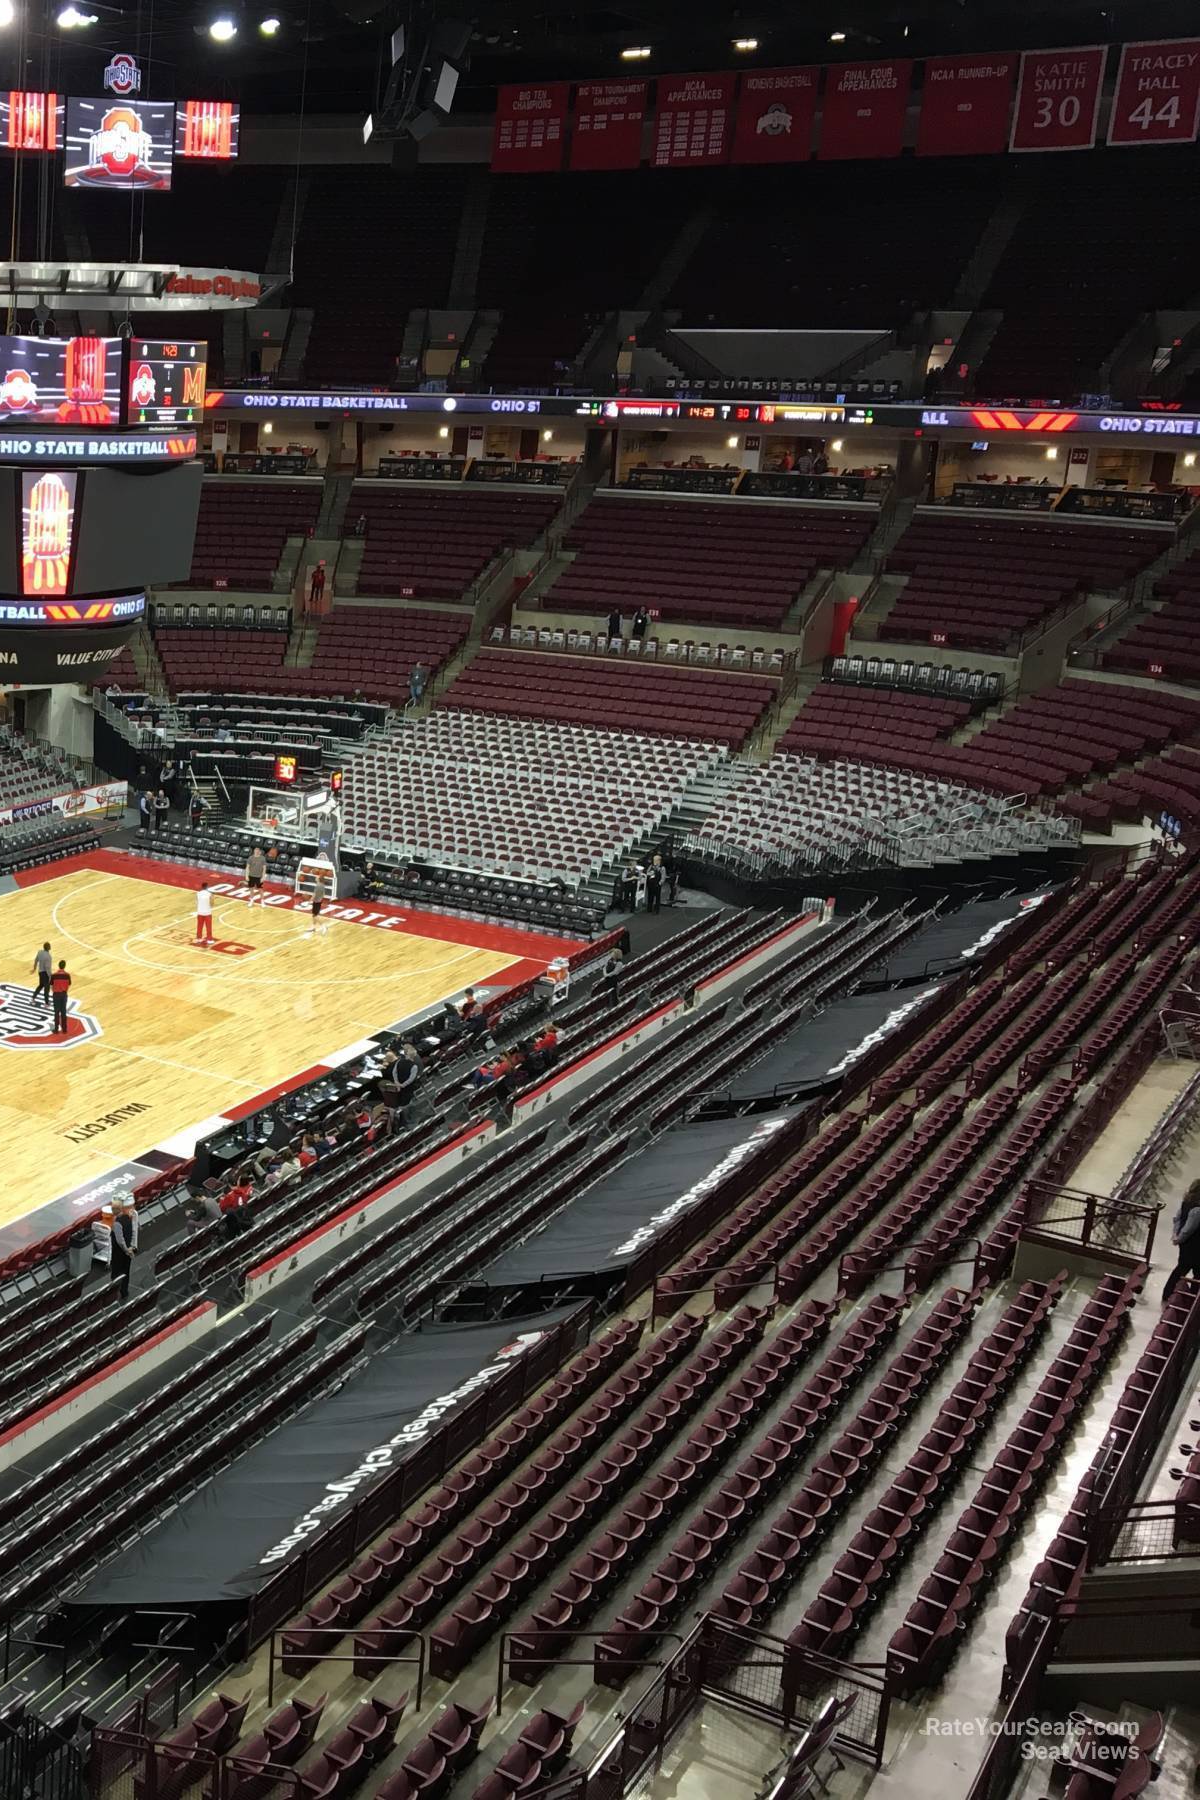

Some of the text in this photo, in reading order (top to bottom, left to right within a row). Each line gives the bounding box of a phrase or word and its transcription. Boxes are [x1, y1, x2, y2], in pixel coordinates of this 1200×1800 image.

[1035, 61, 1088, 77] KATIE
[1130, 52, 1199, 72] TRACEY
[843, 67, 893, 80] FINAL FOUR
[930, 65, 1009, 81] NCAA RUNNER-UP
[578, 83, 646, 96] BIG TEN TOURNAMENT
[685, 79, 706, 91] NCAA
[837, 78, 898, 91] APPEARANCES
[1033, 77, 1086, 92] SMITH
[1138, 75, 1181, 91] HALL
[519, 89, 548, 101] BIG TEN
[593, 96, 628, 106] CHAMPIONS
[667, 89, 722, 102] APPEARANCES
[512, 99, 552, 110] CHAMPIONS
[1033, 95, 1080, 128] 30
[1127, 95, 1181, 130] 44
[243, 394, 408, 409] OHIO STATE BASKETBALL
[490, 399, 527, 412] OHIO
[689, 406, 715, 417] 14:29
[737, 408, 750, 419] 30
[921, 411, 949, 425] ALL
[1099, 417, 1194, 434] OHIO STATE
[34, 441, 85, 455] STATE
[87, 441, 169, 455] BASKETBALL
[1071, 451, 1089, 461] 232
[56, 651, 94, 666] VALUE
[208, 883, 408, 930] OHIO STATE
[105, 1102, 153, 1127] VALUE
[63, 1118, 108, 1144] CITY
[71, 1172, 136, 1207] #GoBucks
